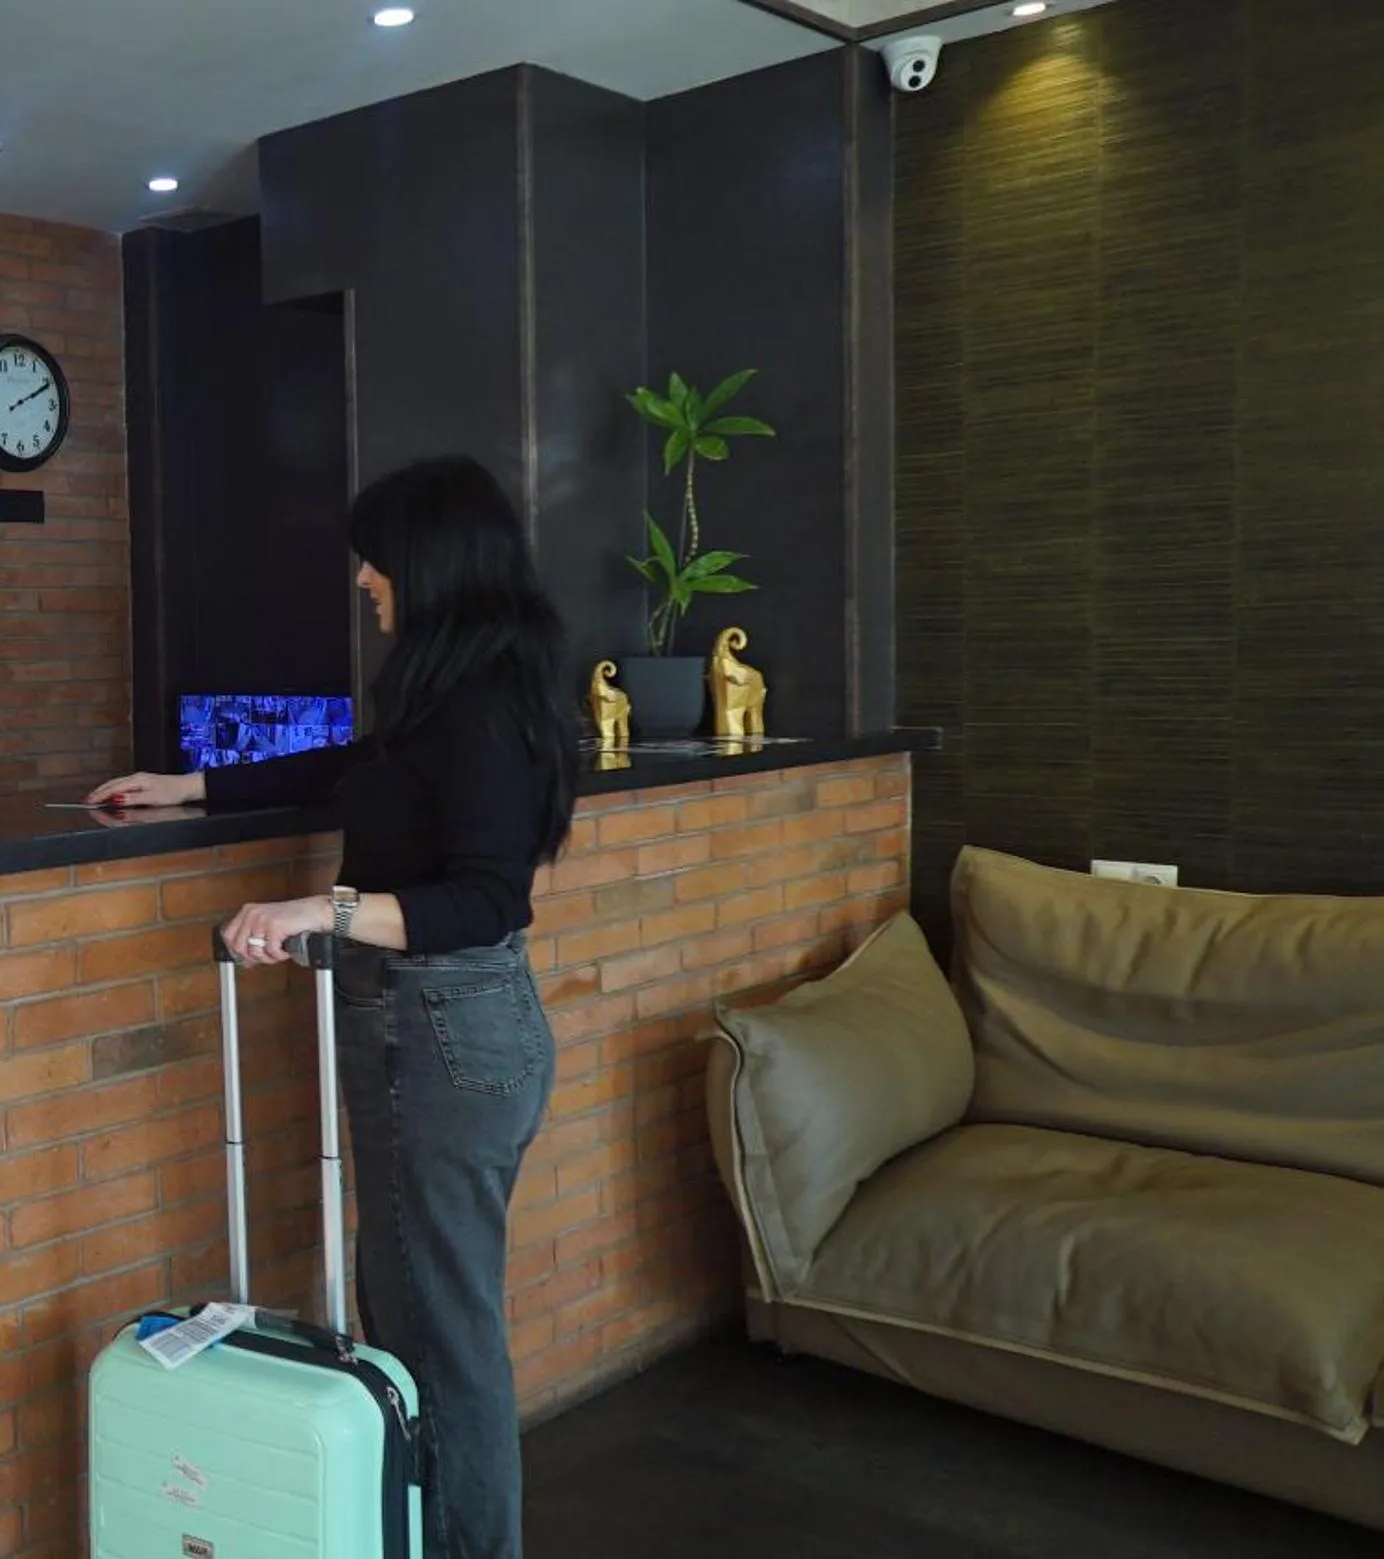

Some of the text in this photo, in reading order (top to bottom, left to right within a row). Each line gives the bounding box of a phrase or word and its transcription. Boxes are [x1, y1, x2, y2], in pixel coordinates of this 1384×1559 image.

[14, 353, 25, 367] 12
[32, 361, 36, 373] 1
[48, 398, 56, 411] 3
[43, 420, 50, 432] 4
[1, 432, 8, 445] 7
[33, 434, 40, 447] 5
[16, 440, 24, 453] 6
